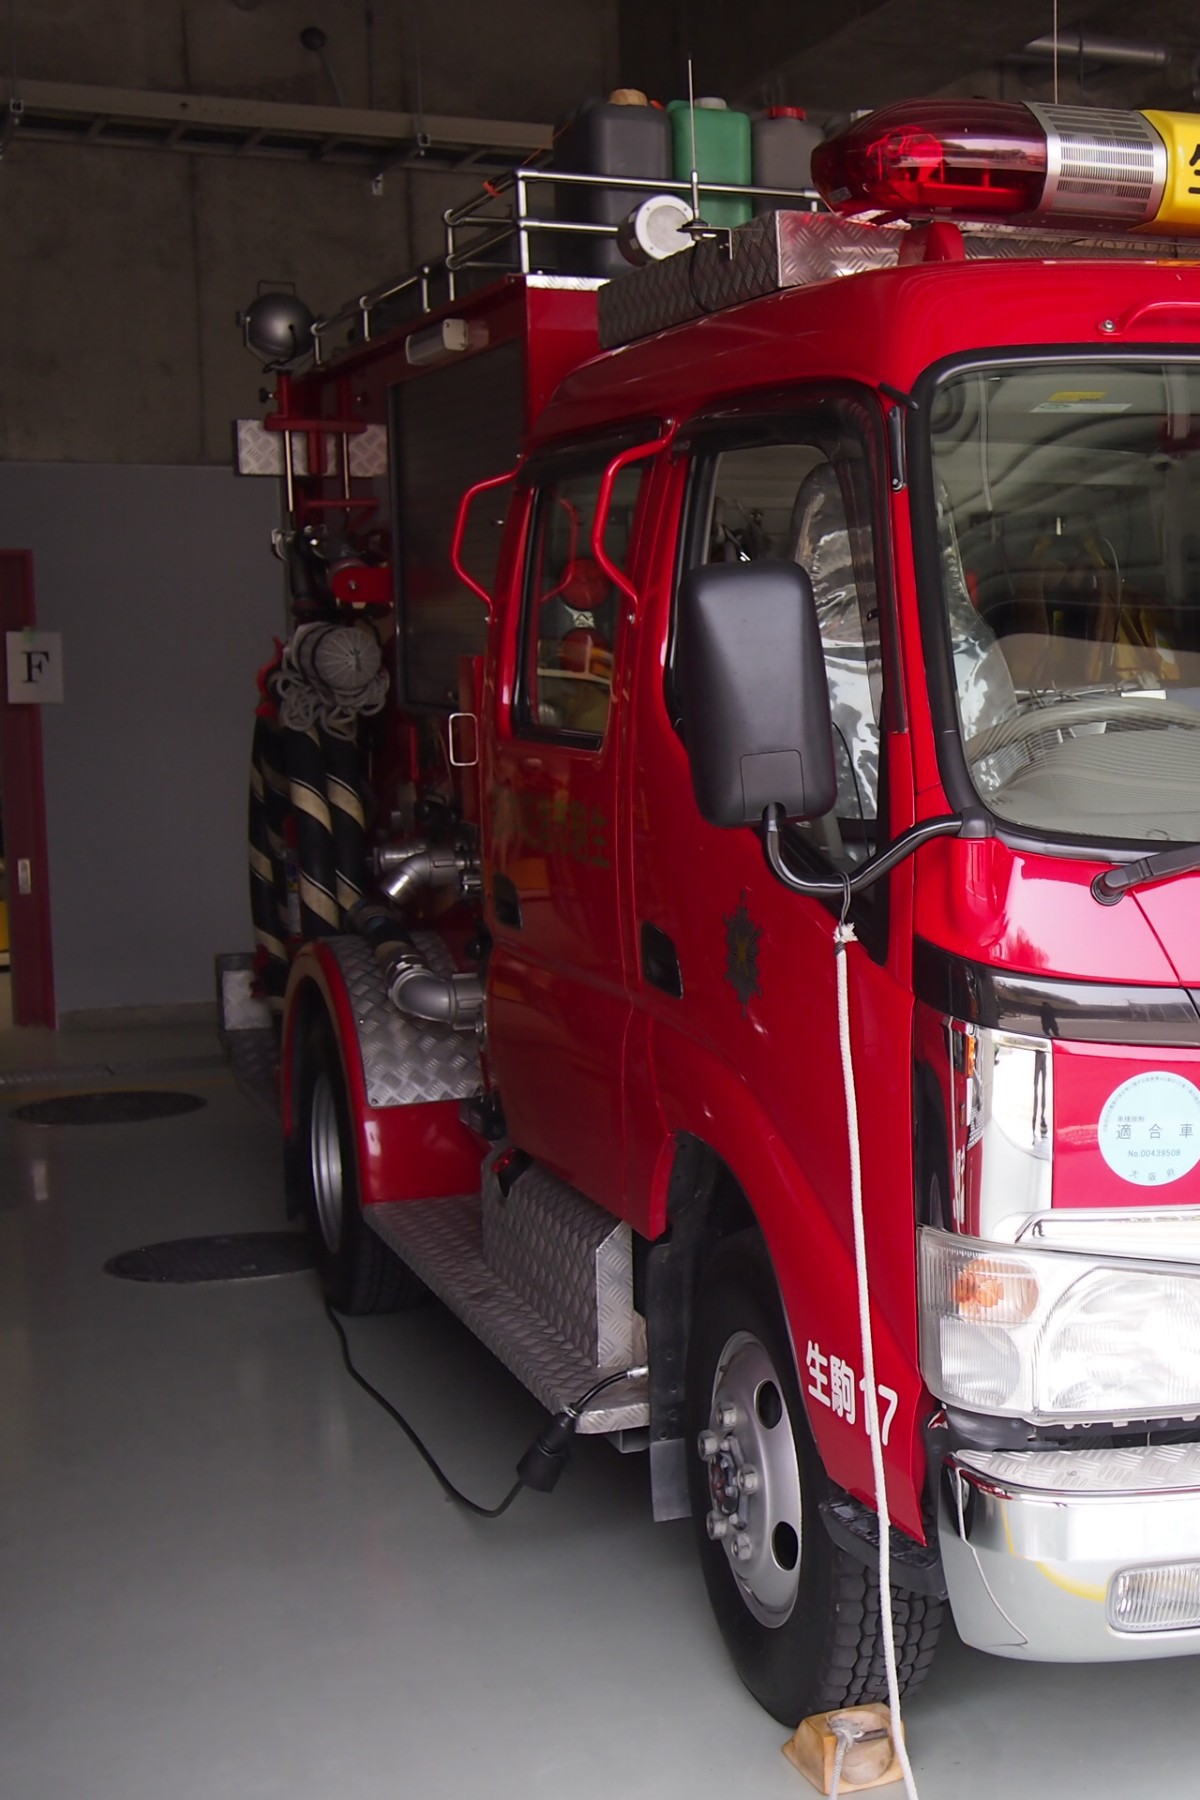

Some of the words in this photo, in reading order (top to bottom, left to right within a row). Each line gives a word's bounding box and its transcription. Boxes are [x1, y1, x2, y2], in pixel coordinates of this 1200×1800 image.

[21, 650, 50, 684] F
[1116, 1123, 1194, 1140] 適合車
